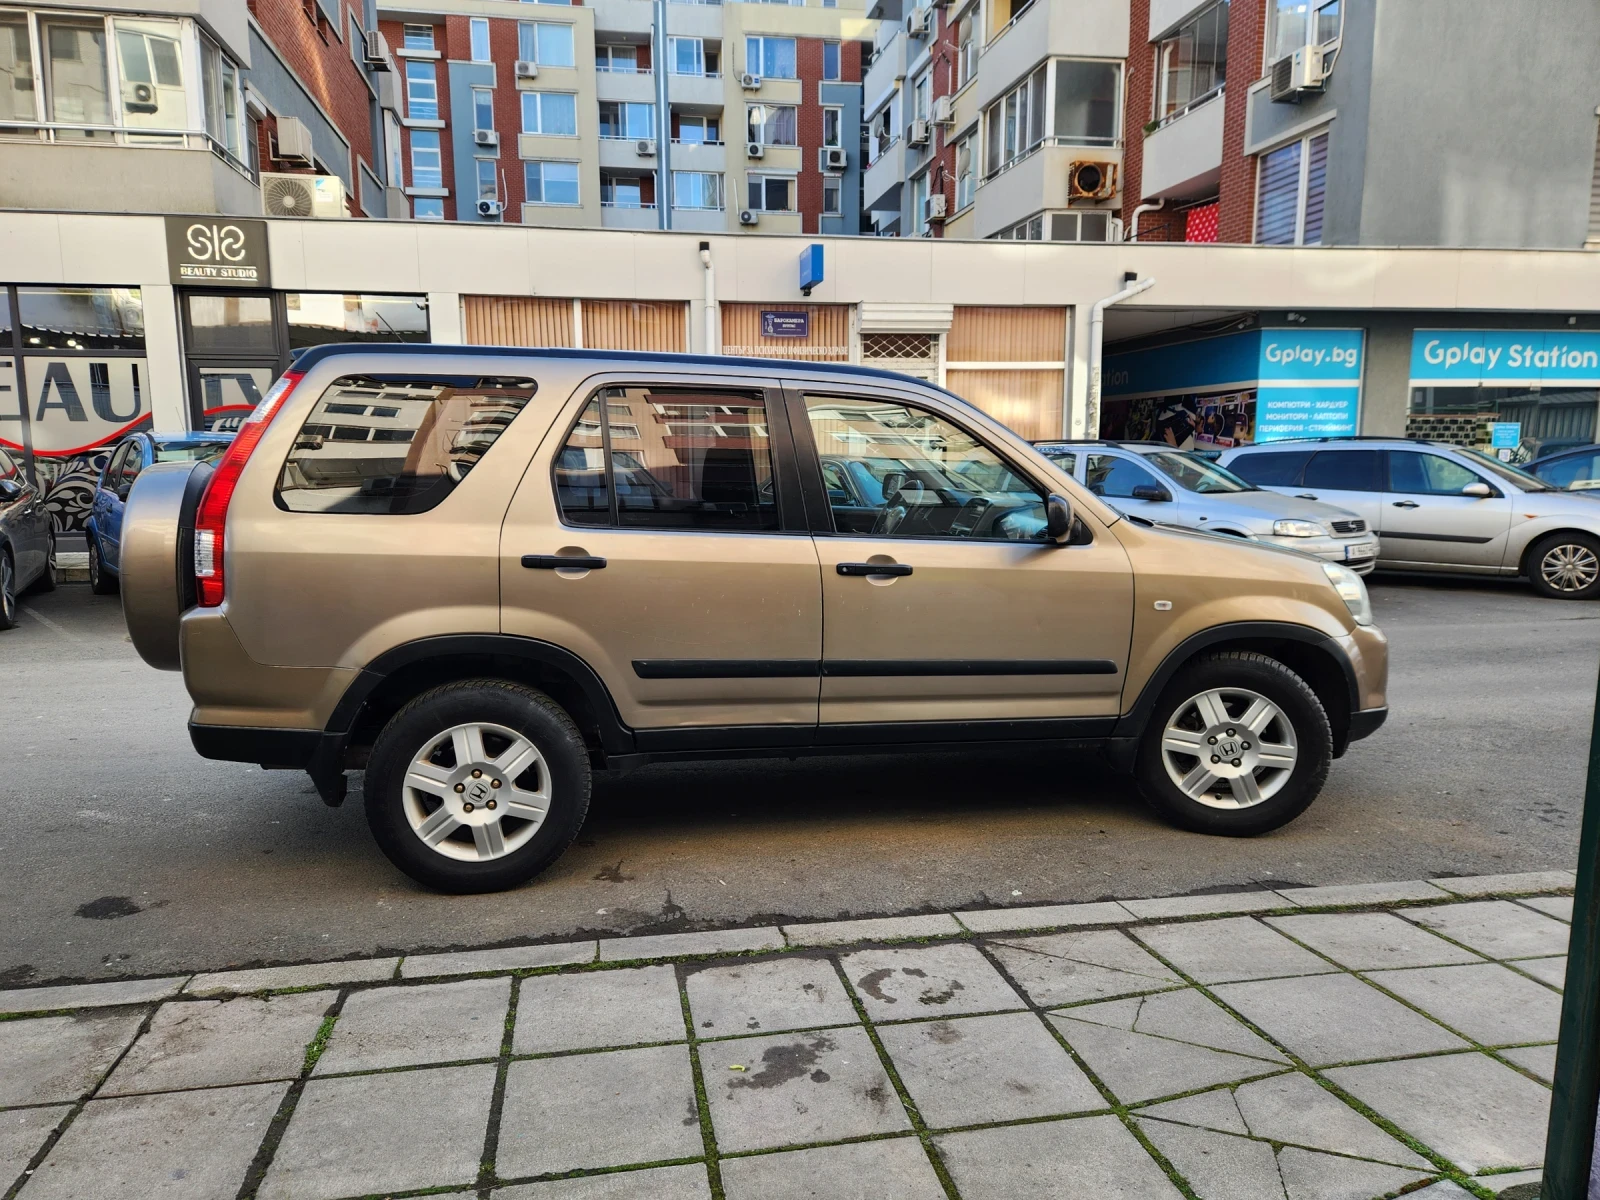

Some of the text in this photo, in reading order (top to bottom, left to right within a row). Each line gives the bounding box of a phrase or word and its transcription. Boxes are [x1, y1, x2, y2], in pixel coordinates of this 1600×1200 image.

[180, 267, 258, 278] BEAUTY STUDIO
[722, 345, 747, 355] ЦЕНТЪР
[746, 345, 754, 355] ЗА
[827, 346, 849, 356] ЗДРАВЕ
[1265, 343, 1358, 368] Gplay.bg
[1423, 339, 1598, 371] Gplay Station
[1267, 401, 1349, 409] КОМПЮТРИ ХАРДУЕР
[1259, 424, 1304, 432] ПЕРИФЕРИЯ
